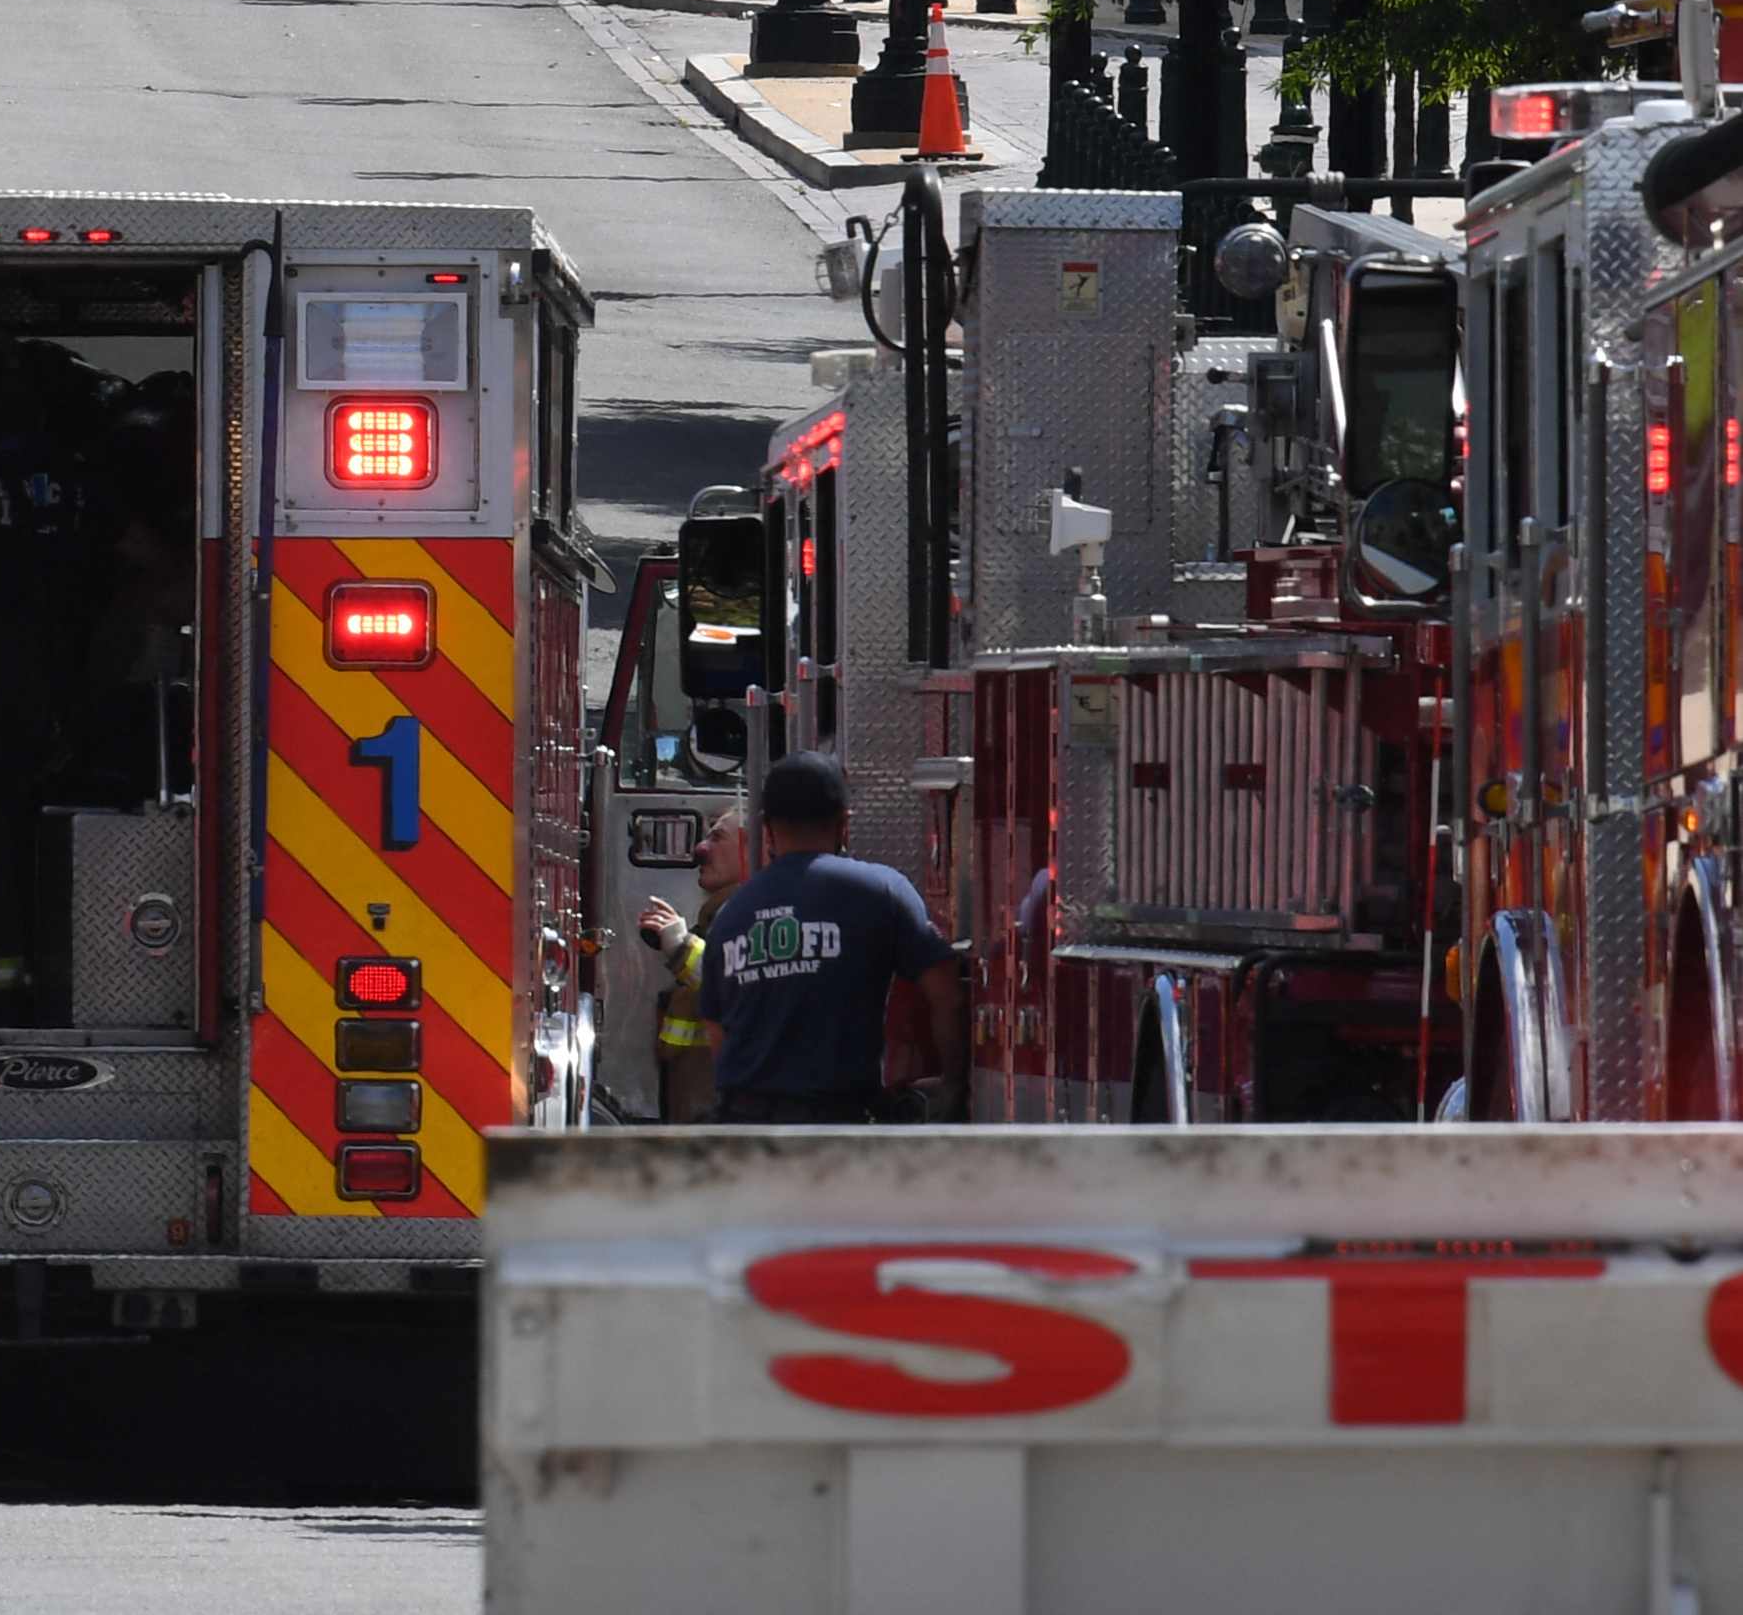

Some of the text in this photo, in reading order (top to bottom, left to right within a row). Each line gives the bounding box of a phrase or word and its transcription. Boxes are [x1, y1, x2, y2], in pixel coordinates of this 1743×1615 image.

[348, 714, 421, 852] 1
[762, 959, 822, 979] WHARF
[744, 1241, 1743, 1419] ST
